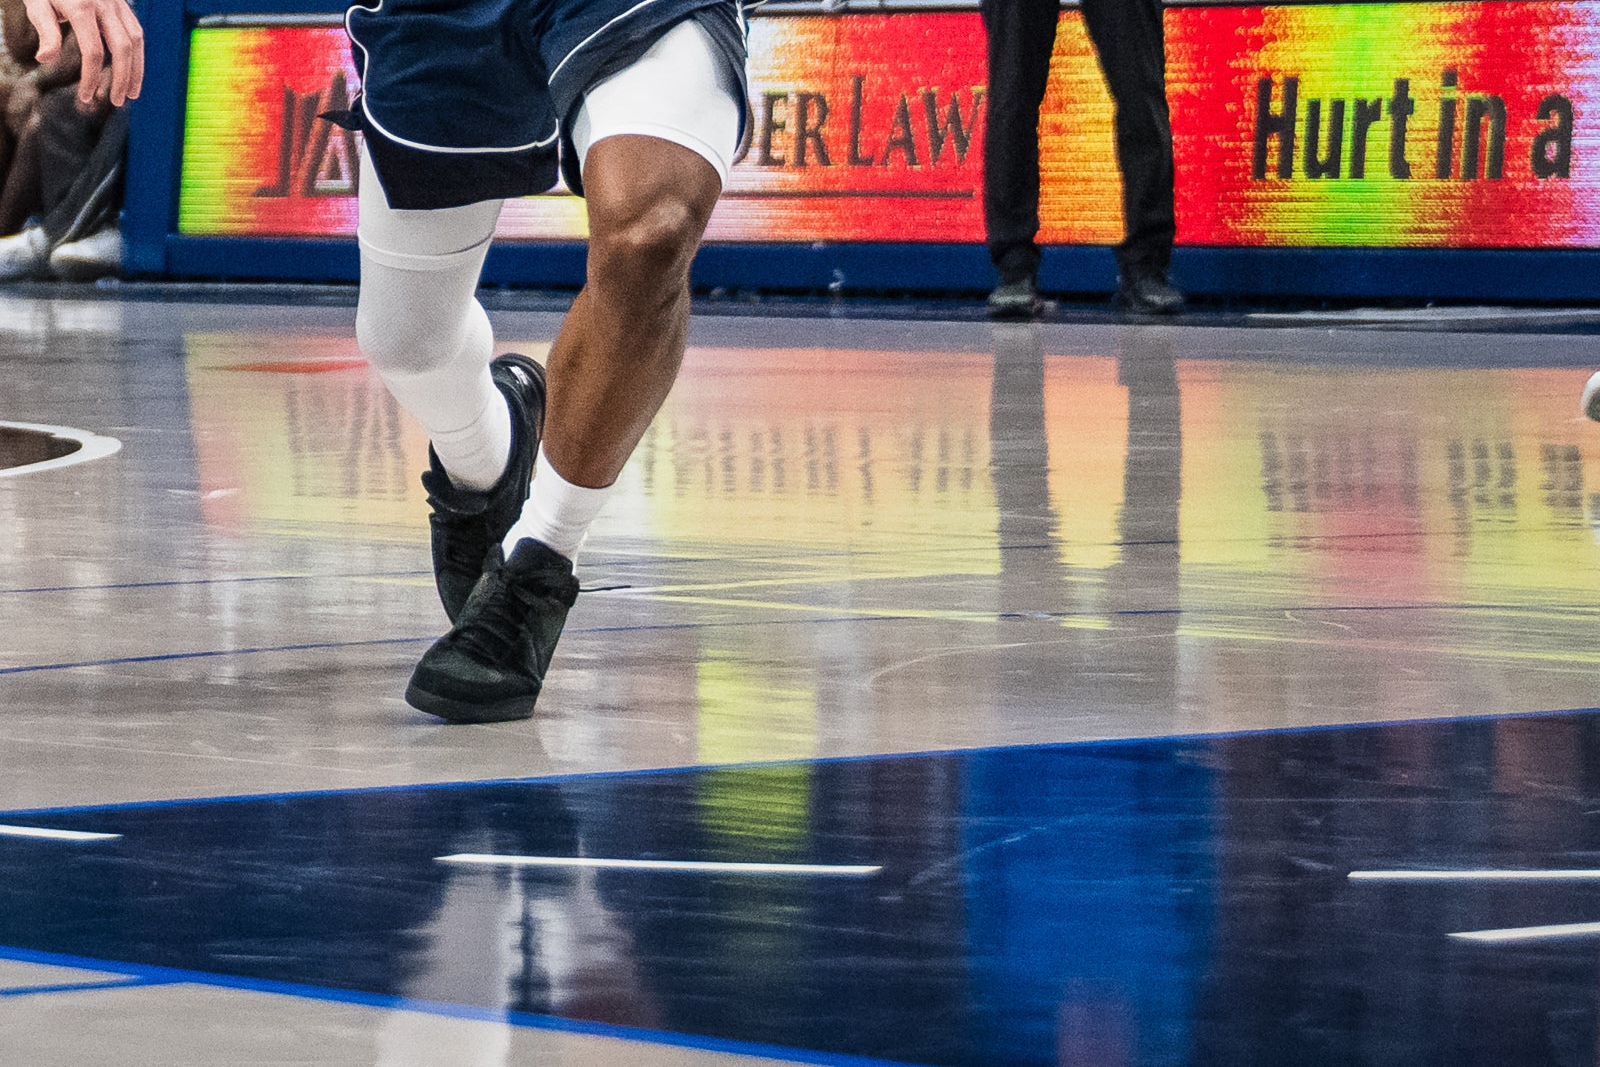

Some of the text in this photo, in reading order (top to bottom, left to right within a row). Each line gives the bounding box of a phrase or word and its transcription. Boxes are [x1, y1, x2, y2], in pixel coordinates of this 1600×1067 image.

[848, 74, 988, 168] LAW
[1252, 68, 1574, 180] Hurt in a
